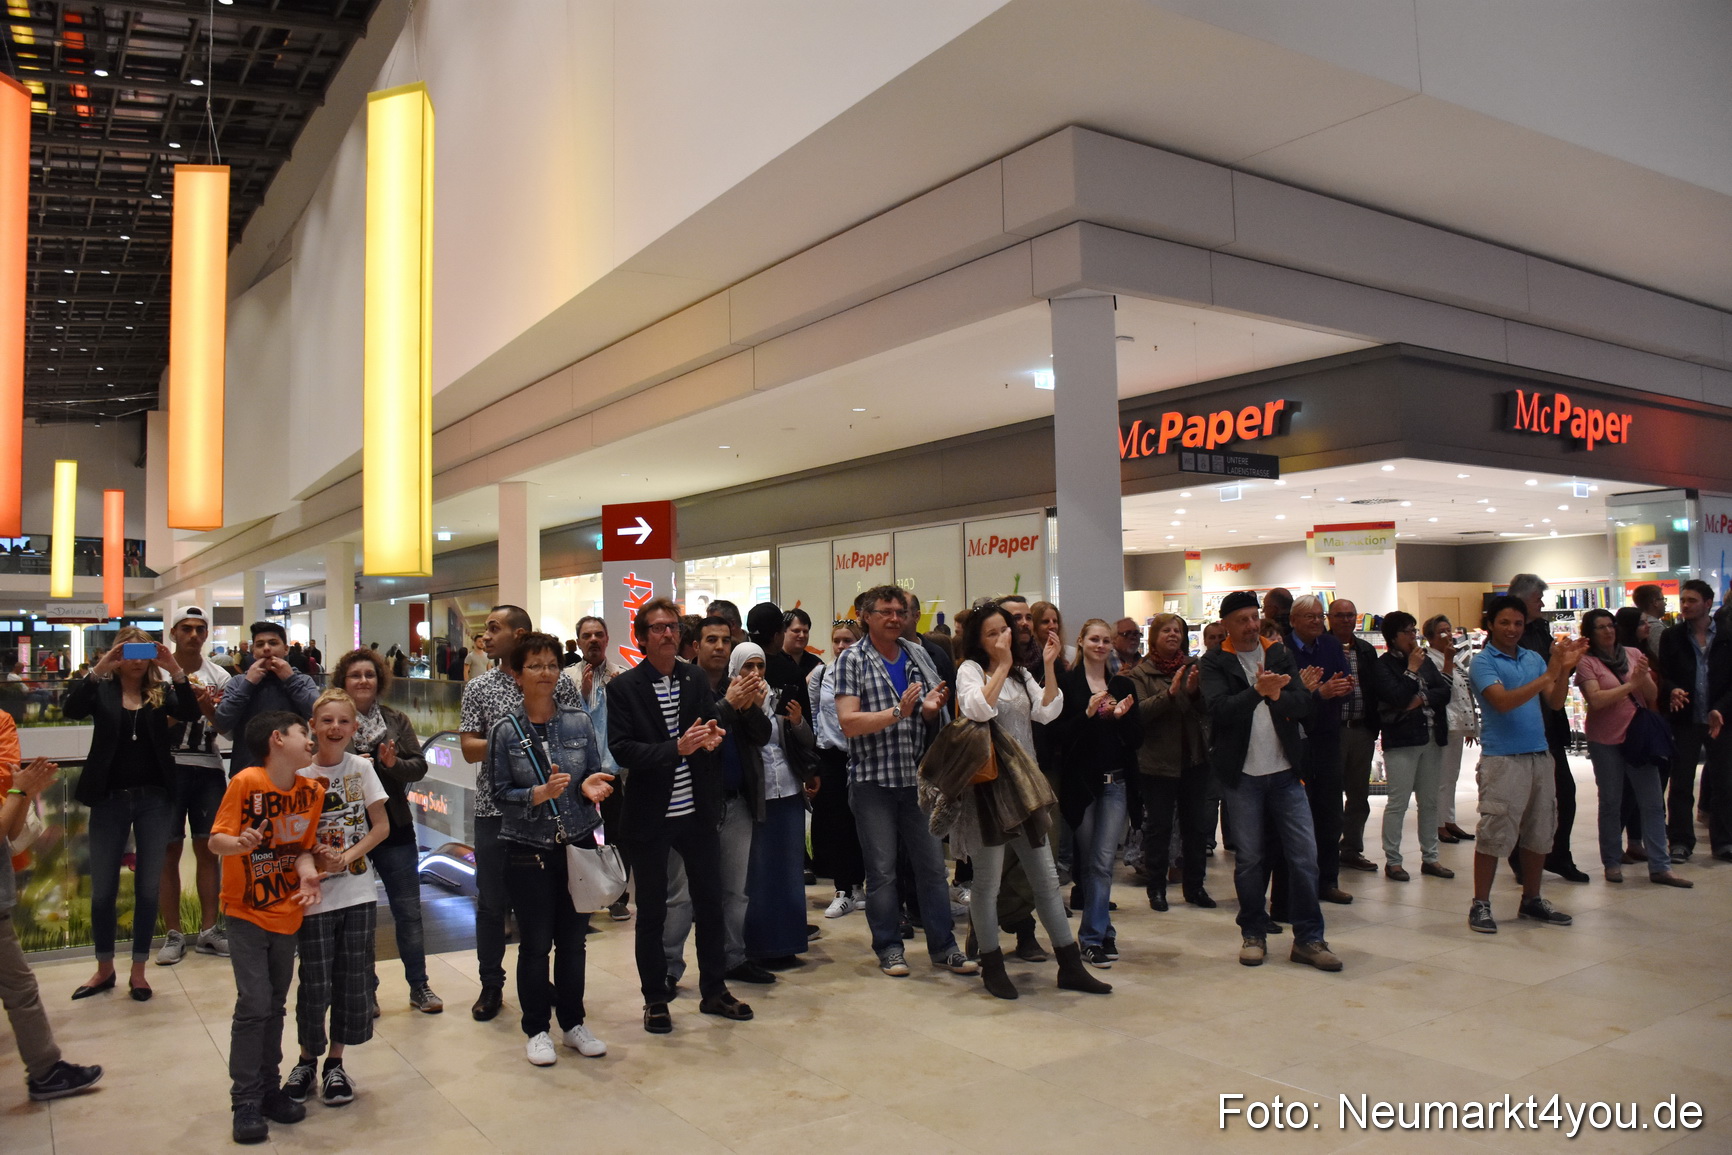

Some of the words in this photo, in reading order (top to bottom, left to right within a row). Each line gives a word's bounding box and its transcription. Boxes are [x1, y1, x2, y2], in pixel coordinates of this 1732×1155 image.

[1118, 399, 1285, 459] McPaper
[1513, 389, 1633, 451] McPaper
[1226, 456, 1249, 465] UNTERE
[1226, 467, 1270, 477] LADENSTRASSE
[967, 535, 1039, 558] McPaper
[835, 551, 889, 572] McPaper
[1214, 562, 1252, 573] McPaper
[48, 606, 92, 618] Delizia
[618, 572, 653, 668] Mkt
